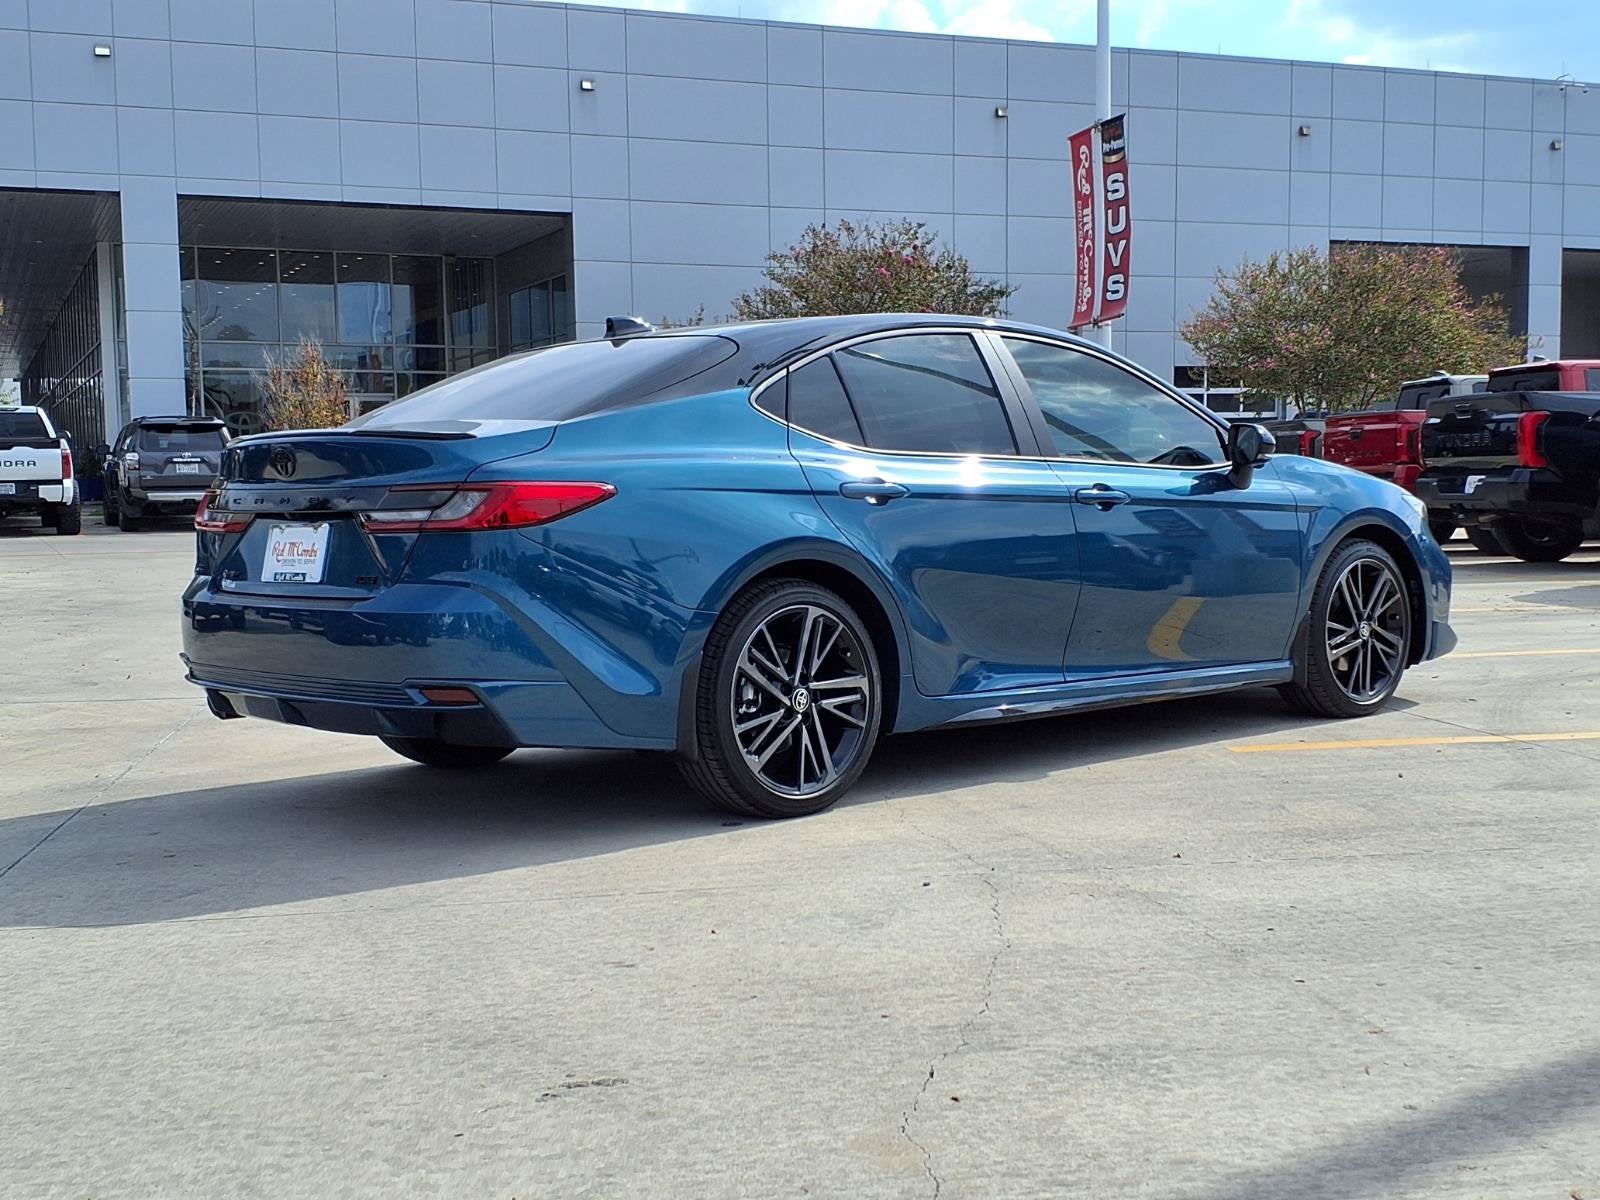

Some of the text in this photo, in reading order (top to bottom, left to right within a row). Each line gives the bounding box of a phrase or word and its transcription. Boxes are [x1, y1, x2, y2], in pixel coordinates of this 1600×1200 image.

[1078, 145, 1094, 312] Red McCombs
[1106, 172, 1127, 301] SUVS
[272, 540, 320, 563] Red McCombs
